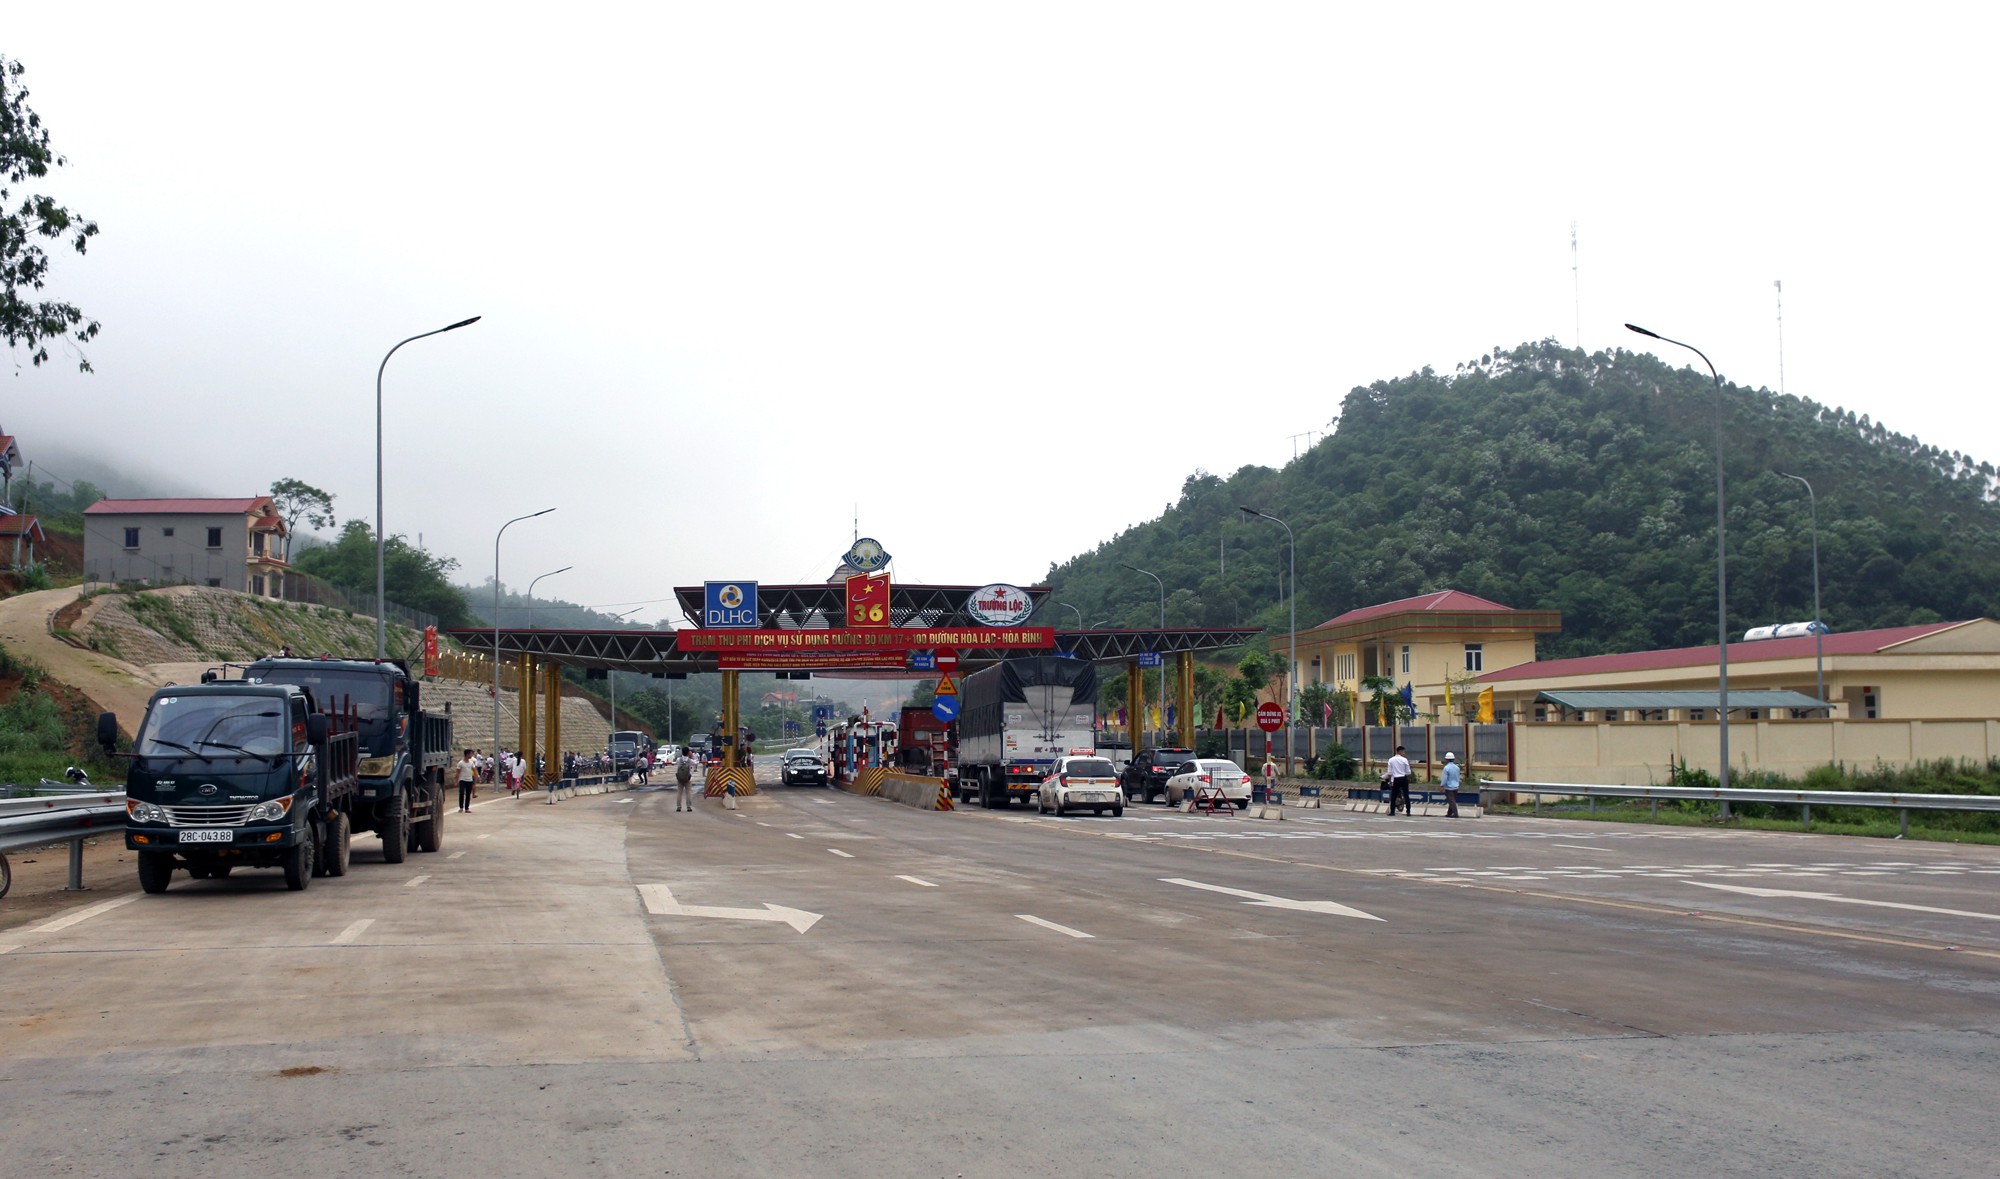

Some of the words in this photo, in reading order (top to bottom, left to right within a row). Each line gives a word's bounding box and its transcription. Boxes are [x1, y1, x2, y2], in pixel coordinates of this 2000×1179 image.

[853, 603, 884, 622] 36
[978, 598, 1007, 611] TRƯỜNG
[1009, 599, 1023, 613] LỘC
[709, 609, 753, 624] DLHC
[691, 634, 716, 648] TRẠM
[718, 634, 734, 646] THU
[736, 632, 751, 646] PHÍ
[754, 634, 774, 648] DỊCH
[777, 634, 789, 648] VỤ
[790, 630, 803, 646] SỬ
[805, 634, 829, 648] DỤNG
[832, 631, 862, 646] ĐƯỜNG
[864, 632, 876, 647] BỘ
[878, 634, 892, 645] KM
[894, 634, 904, 645] 17
[912, 633, 927, 644] 100
[929, 630, 959, 644] ĐƯỜNG
[960, 631, 978, 644] HÒA
[980, 632, 996, 646] LẠC
[1002, 630, 1020, 643] HÒA
[1022, 630, 1042, 643] BÌNH
[181, 831, 232, 842] 28C-043.88
